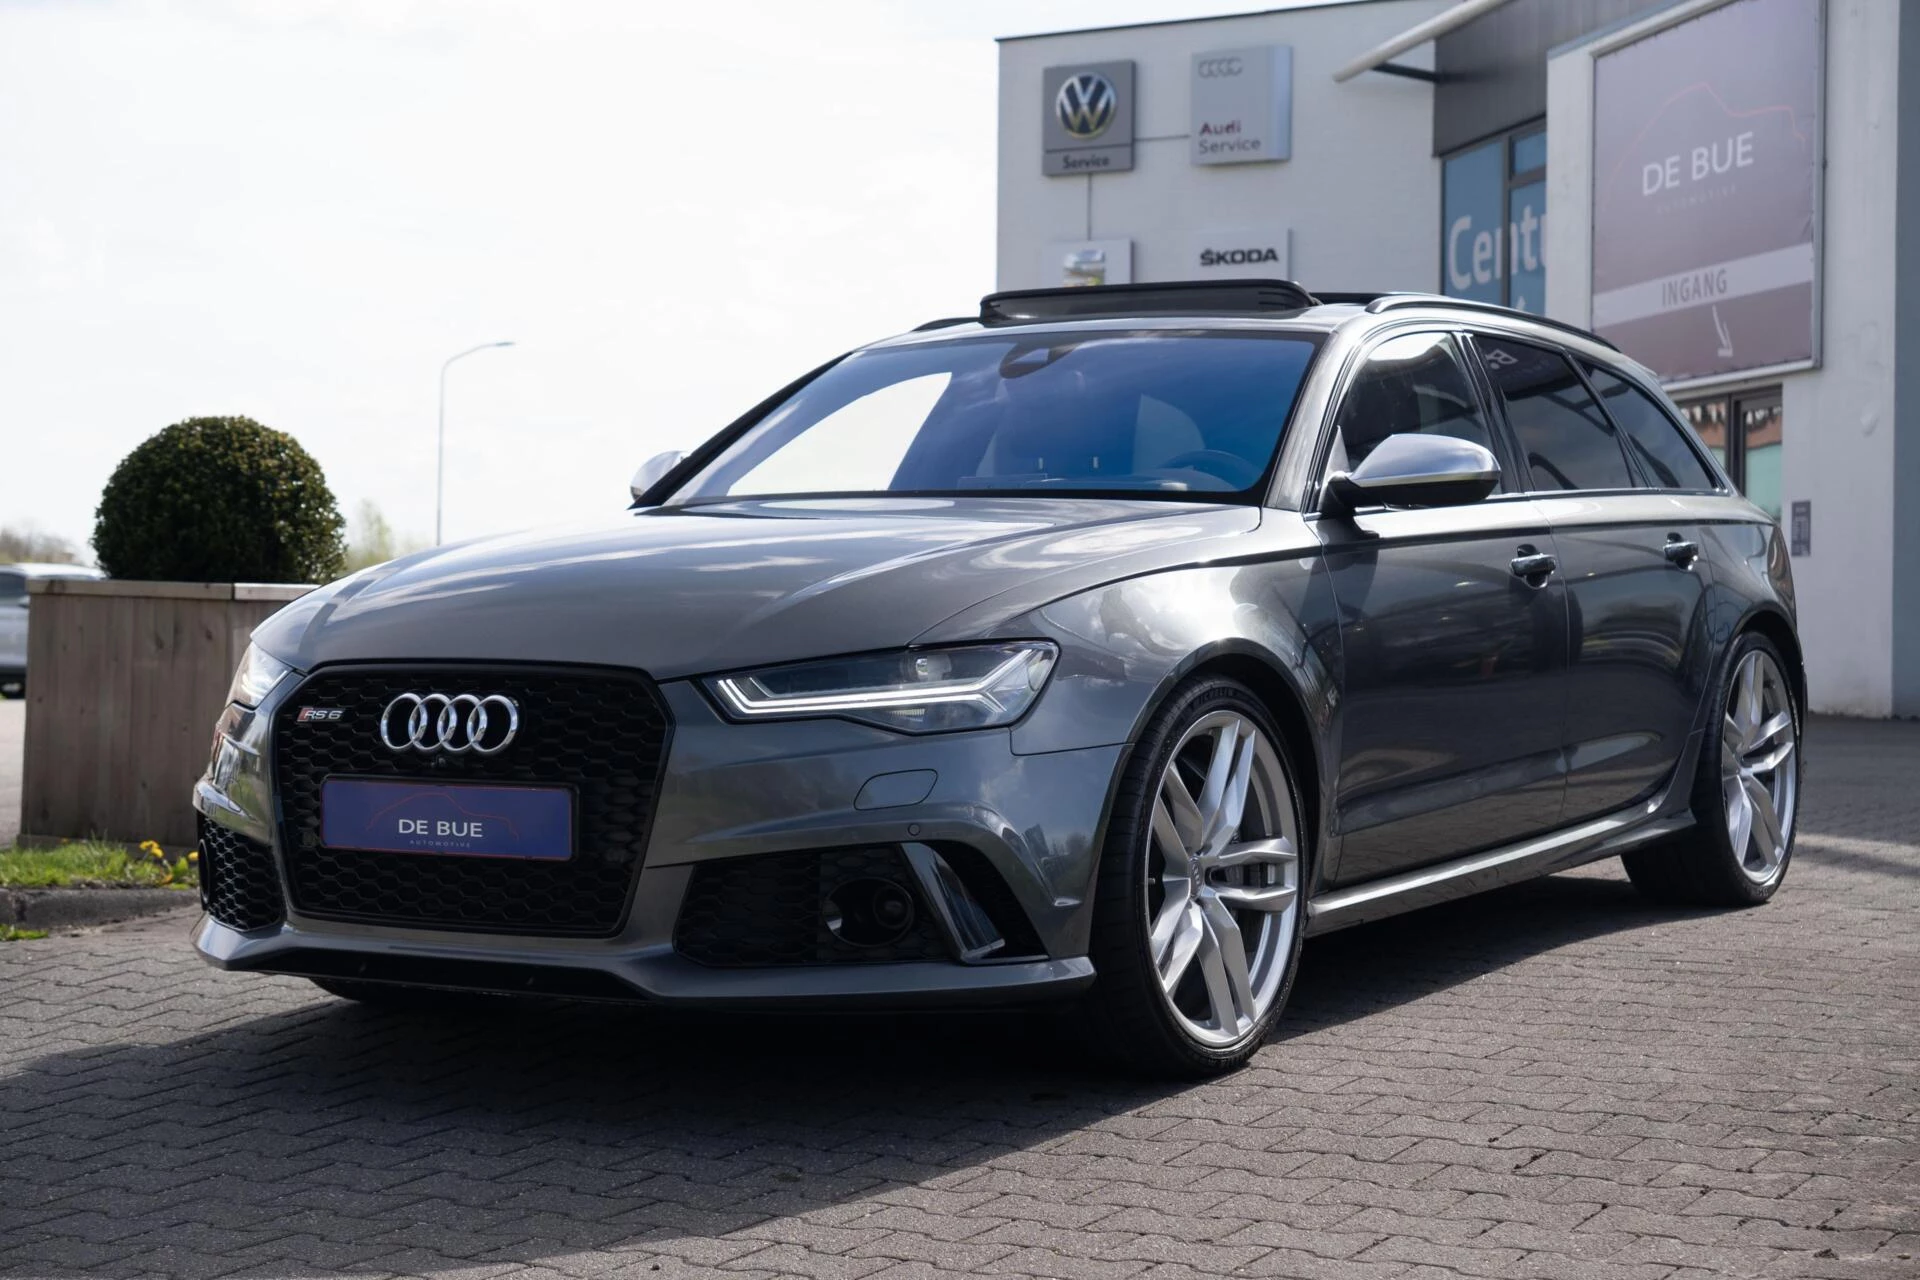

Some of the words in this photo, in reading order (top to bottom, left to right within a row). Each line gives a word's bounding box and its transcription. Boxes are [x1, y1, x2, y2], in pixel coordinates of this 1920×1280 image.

[1199, 121, 1241, 135] Audi
[1199, 138, 1261, 154] Service
[1062, 154, 1110, 169] Service
[1642, 154, 1680, 196] DE
[1692, 131, 1754, 181] BUE
[1200, 248, 1278, 266] ŠKODA
[1662, 268, 1727, 307] INGANG
[398, 819, 428, 834] DE
[437, 821, 483, 837] BUE
[409, 840, 470, 848] AUTOMOTIVE
